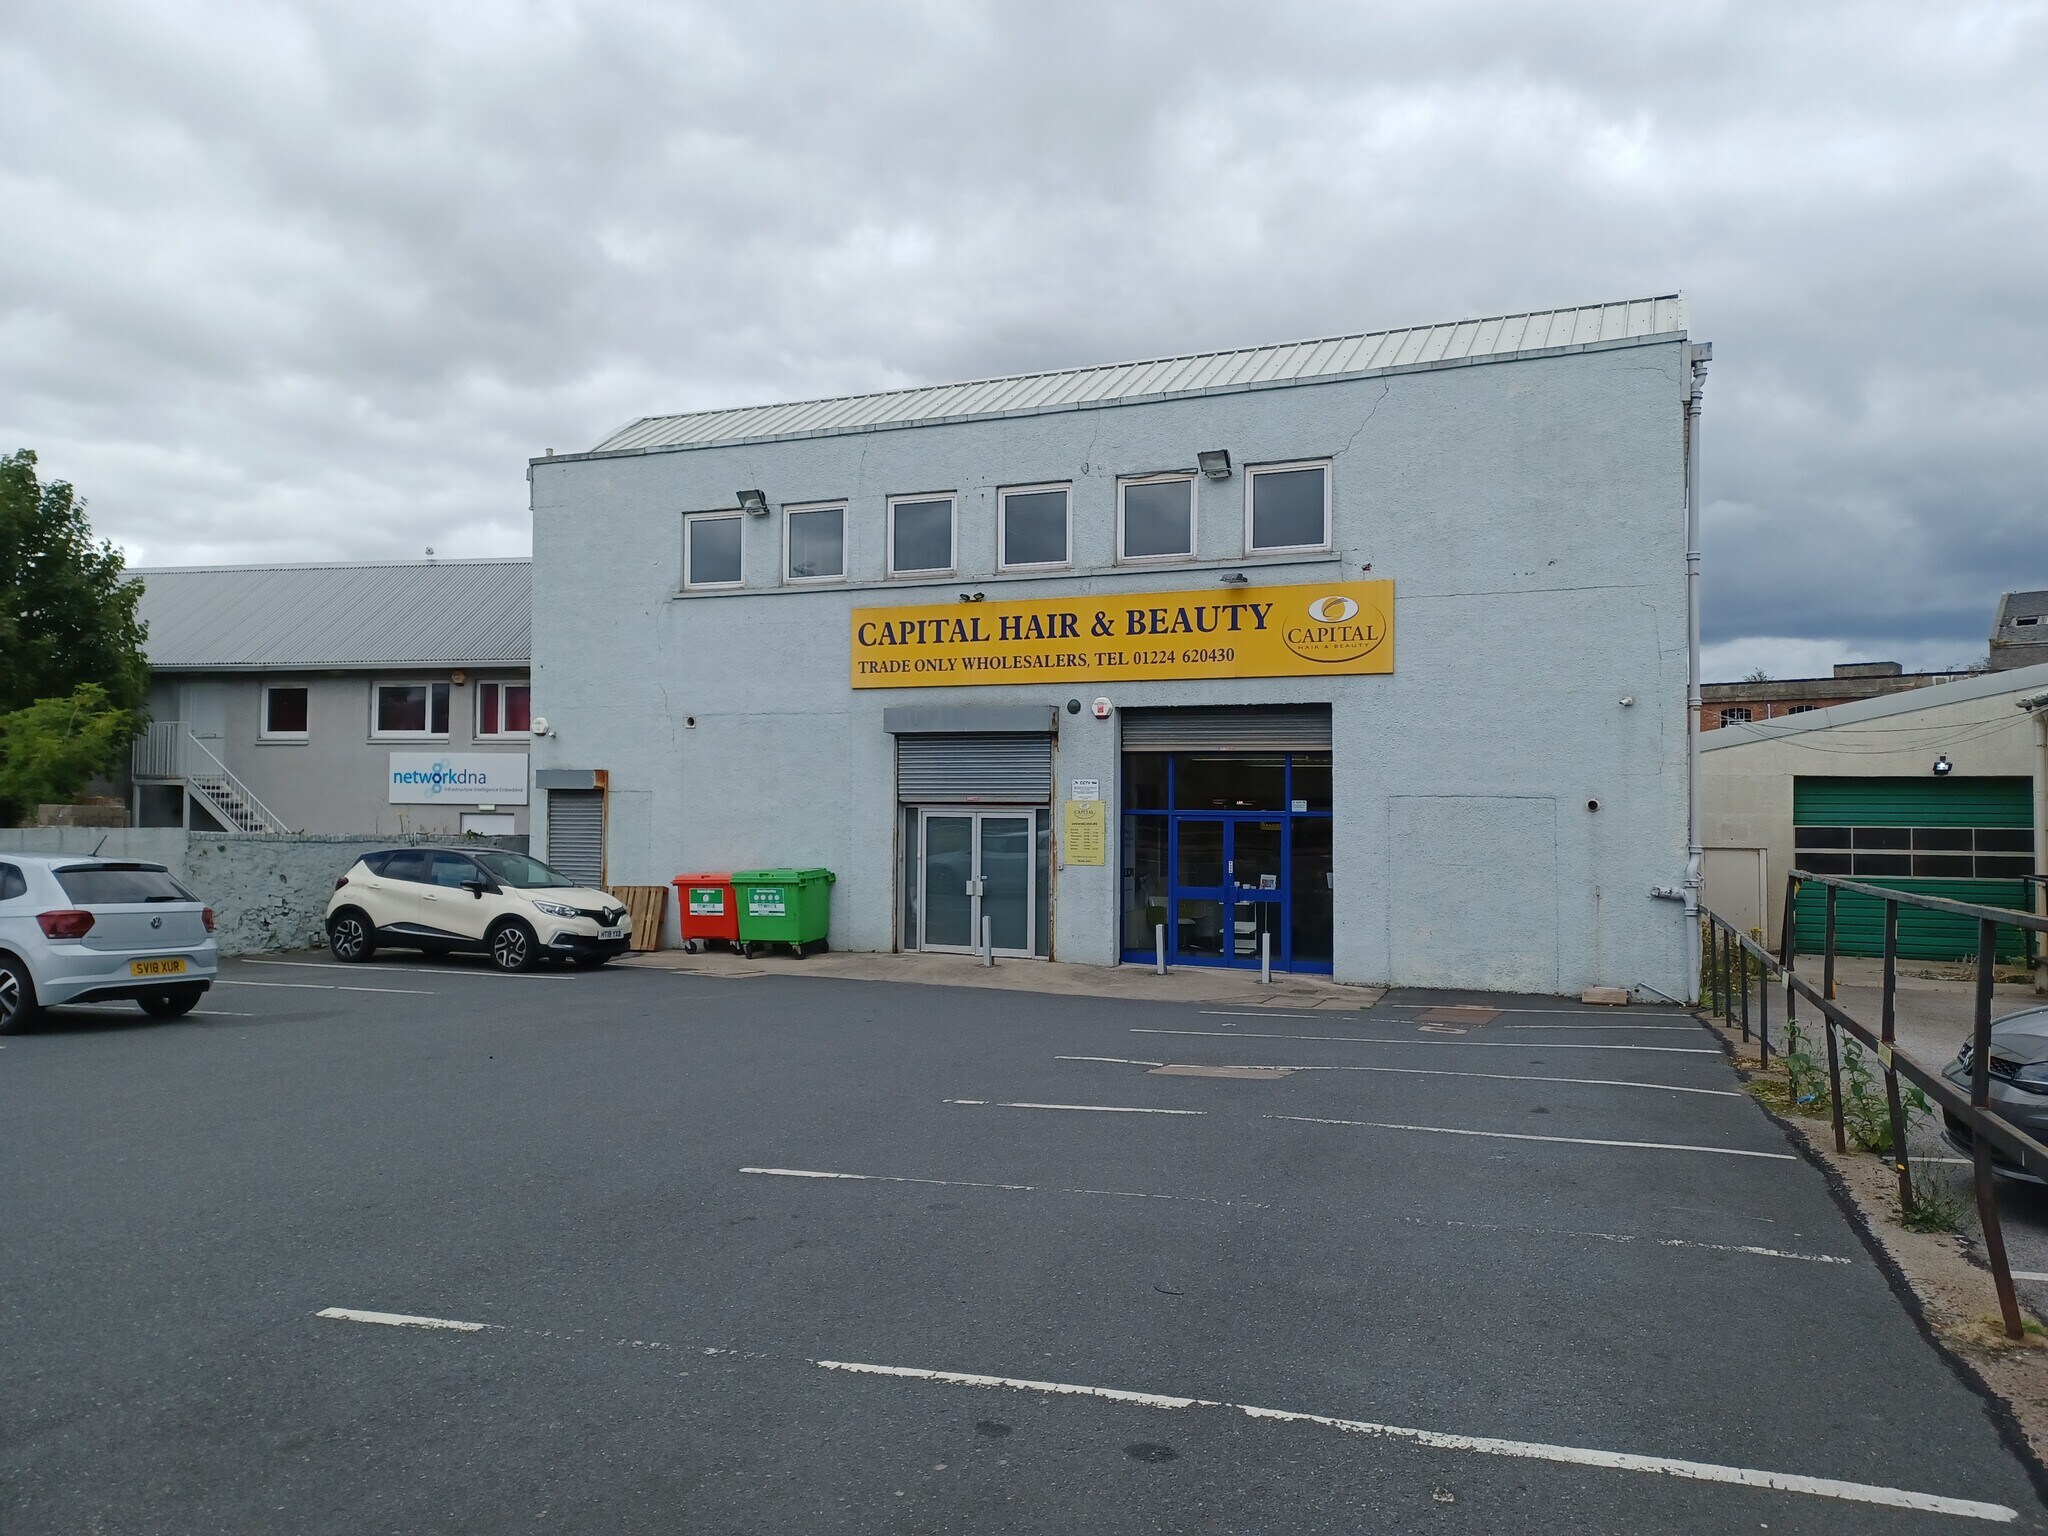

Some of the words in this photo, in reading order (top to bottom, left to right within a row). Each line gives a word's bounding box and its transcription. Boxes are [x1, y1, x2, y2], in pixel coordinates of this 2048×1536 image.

[858, 617, 991, 647] CAPITAL
[998, 612, 1081, 641] HAIR
[1090, 610, 1115, 637] &
[1125, 602, 1274, 636] BEAUTY
[1287, 625, 1379, 644] CAPITAL
[857, 659, 911, 674] TRADE
[914, 658, 958, 672] ONLY
[962, 652, 1090, 671] WHOLESALERS,
[1093, 651, 1130, 667] TEL
[1133, 650, 1176, 665] 01224
[1182, 647, 1235, 663] 620430
[393, 768, 487, 784] networkdna
[136, 963, 159, 973] SV18
[161, 961, 179, 972] XUR
